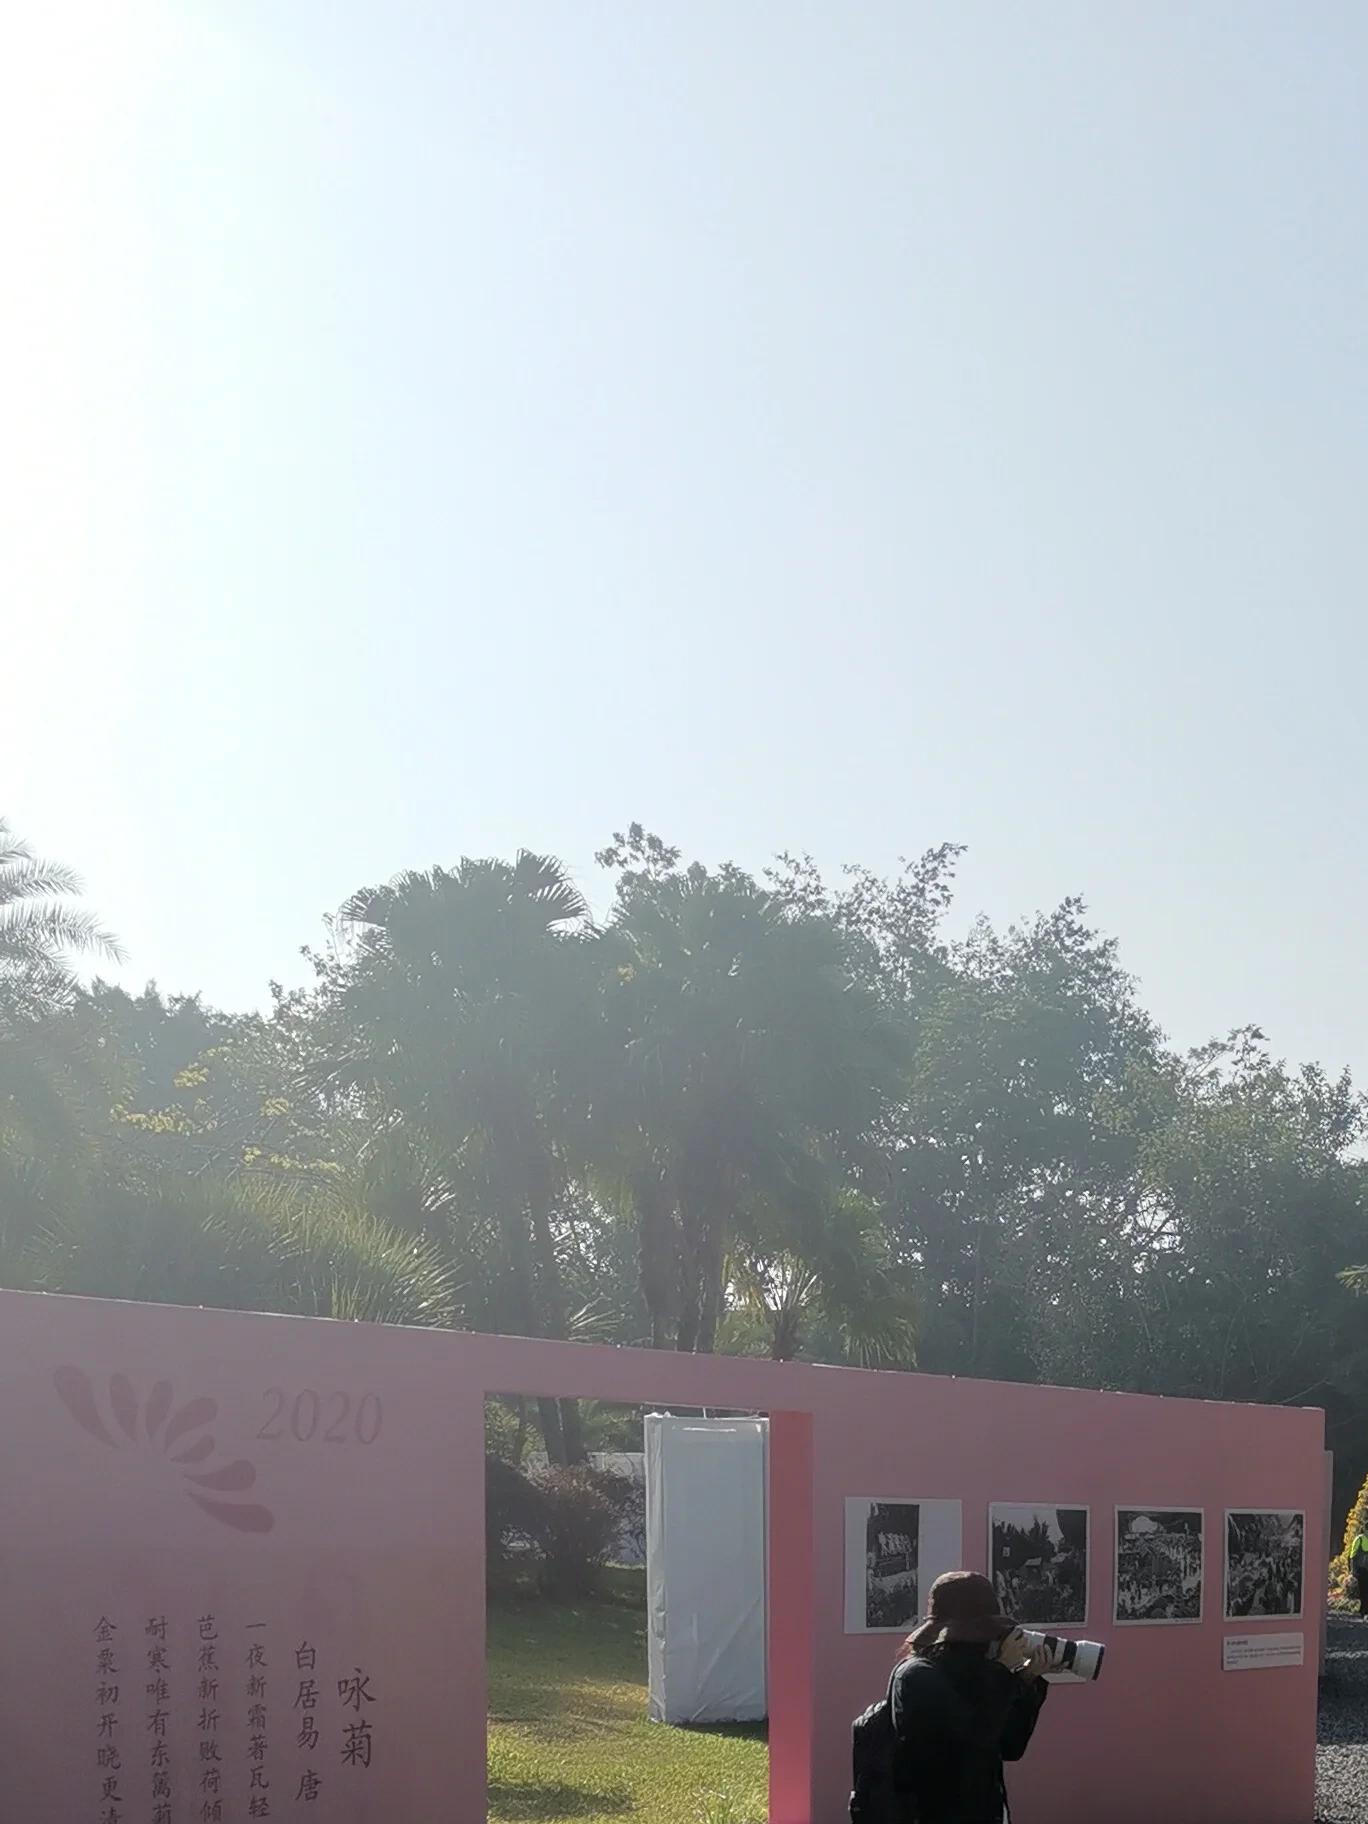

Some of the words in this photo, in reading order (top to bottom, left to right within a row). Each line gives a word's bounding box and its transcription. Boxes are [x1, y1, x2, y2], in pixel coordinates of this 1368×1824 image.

[256, 1387, 382, 1444] 2020
[292, 1640, 320, 1750] 白居易
[337, 1666, 377, 1768] 咏菊
[295, 1769, 322, 1802] 唐
